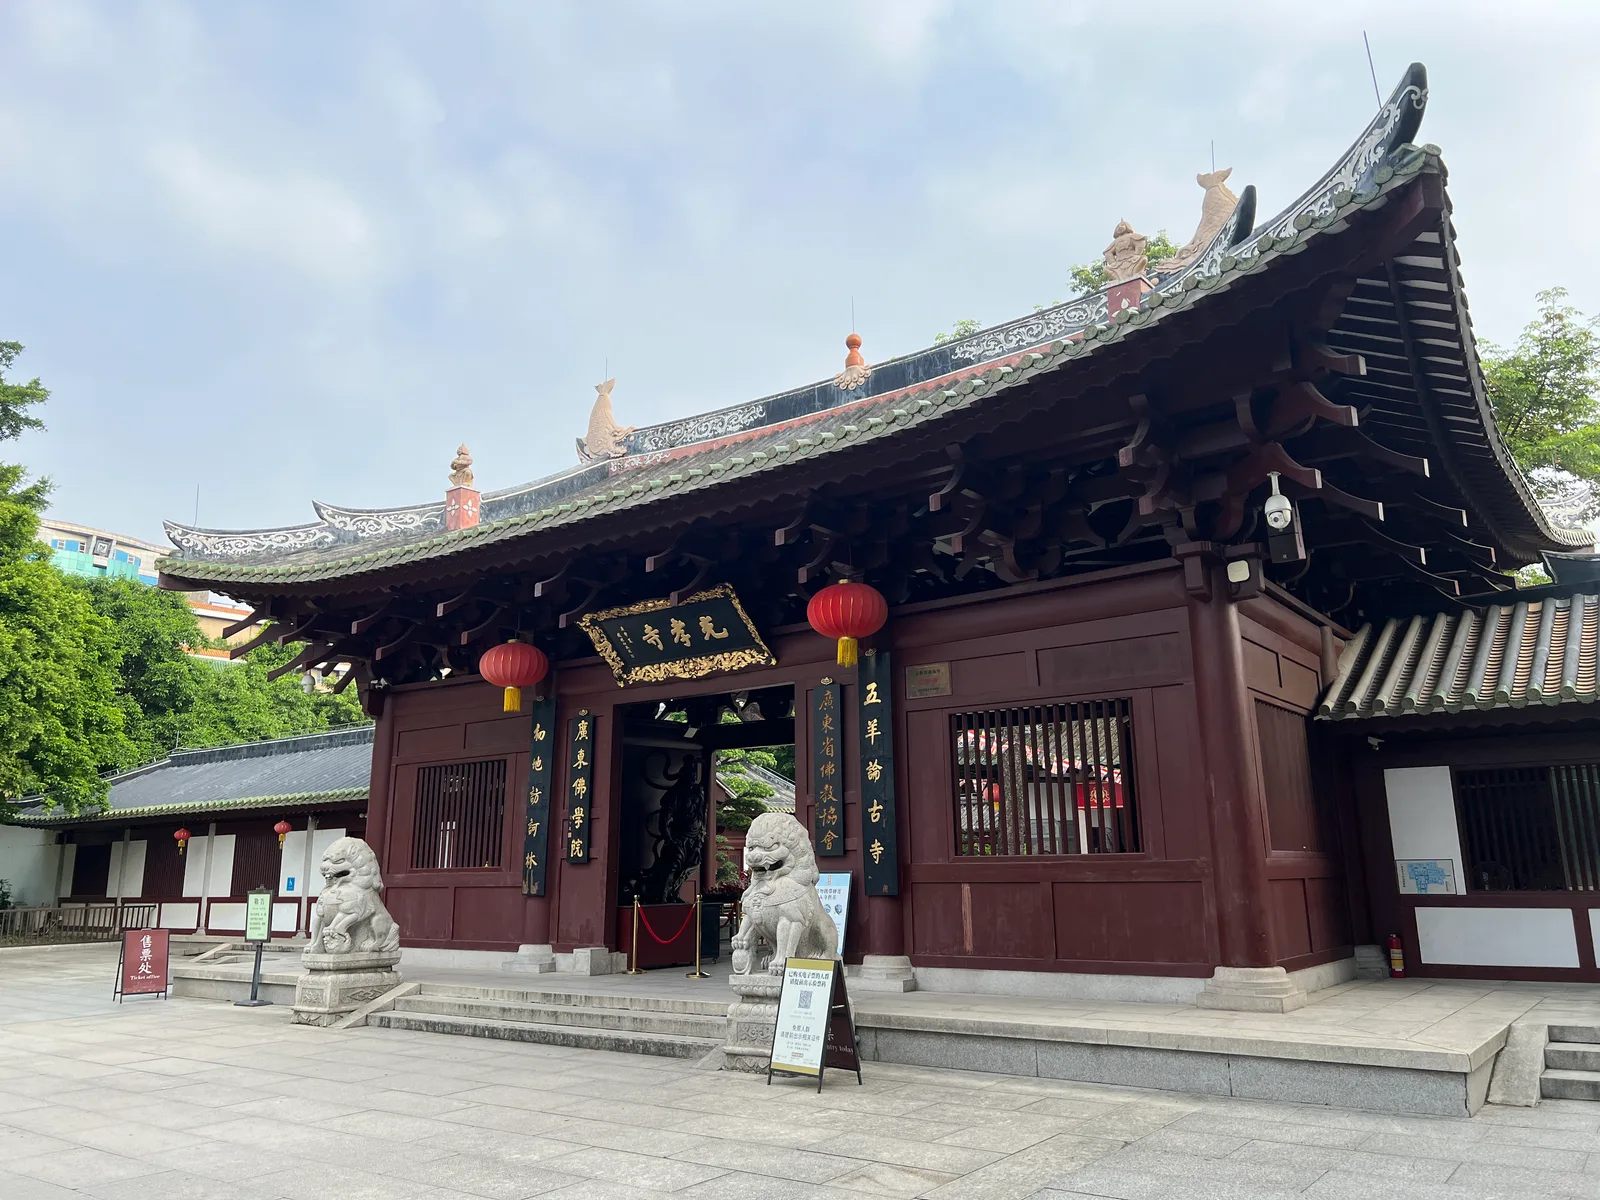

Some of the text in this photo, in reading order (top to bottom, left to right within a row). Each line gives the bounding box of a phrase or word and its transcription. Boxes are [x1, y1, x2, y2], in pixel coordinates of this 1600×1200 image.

[569, 719, 590, 858] 廣東佛學院
[863, 681, 885, 865] 五羊論古寺
[138, 934, 153, 974] 售票处
[826, 1044, 854, 1055] ntry today
